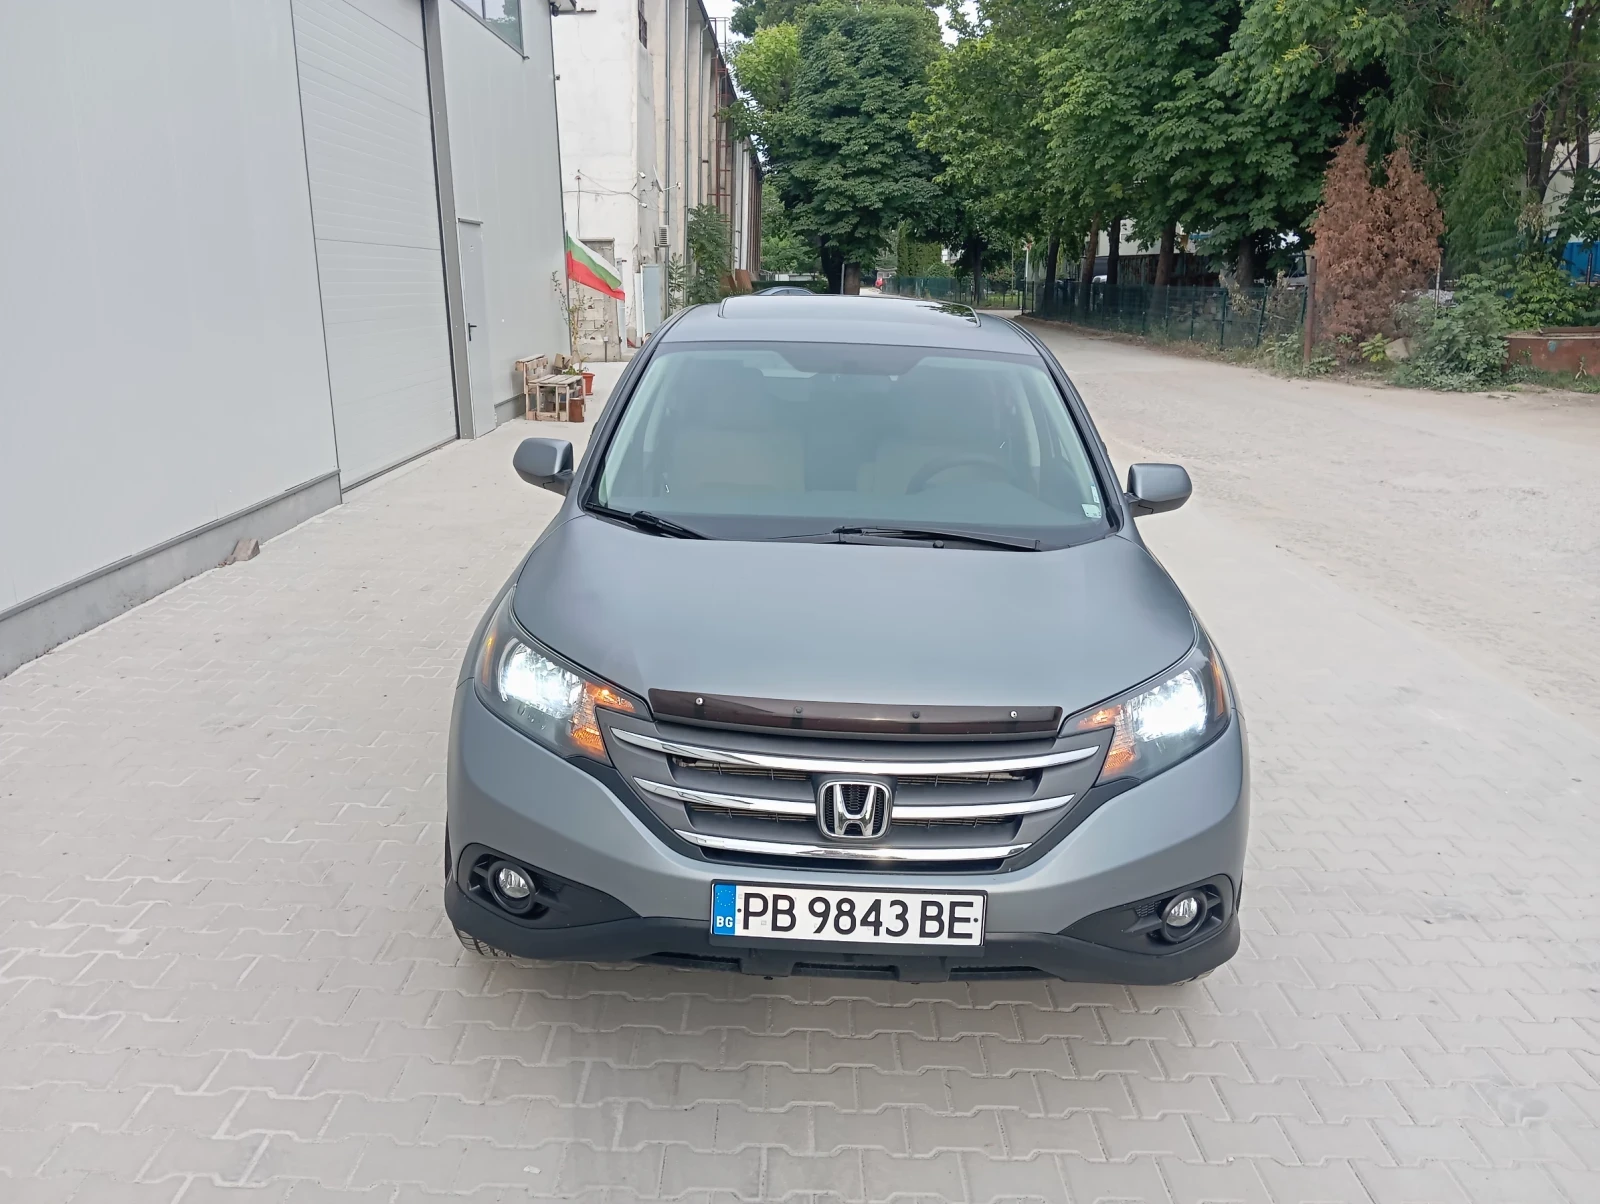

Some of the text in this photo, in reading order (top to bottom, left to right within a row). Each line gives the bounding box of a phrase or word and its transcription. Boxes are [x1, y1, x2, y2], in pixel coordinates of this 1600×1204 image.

[716, 916, 733, 928] BG
[743, 892, 974, 939] PB 9843 BE
